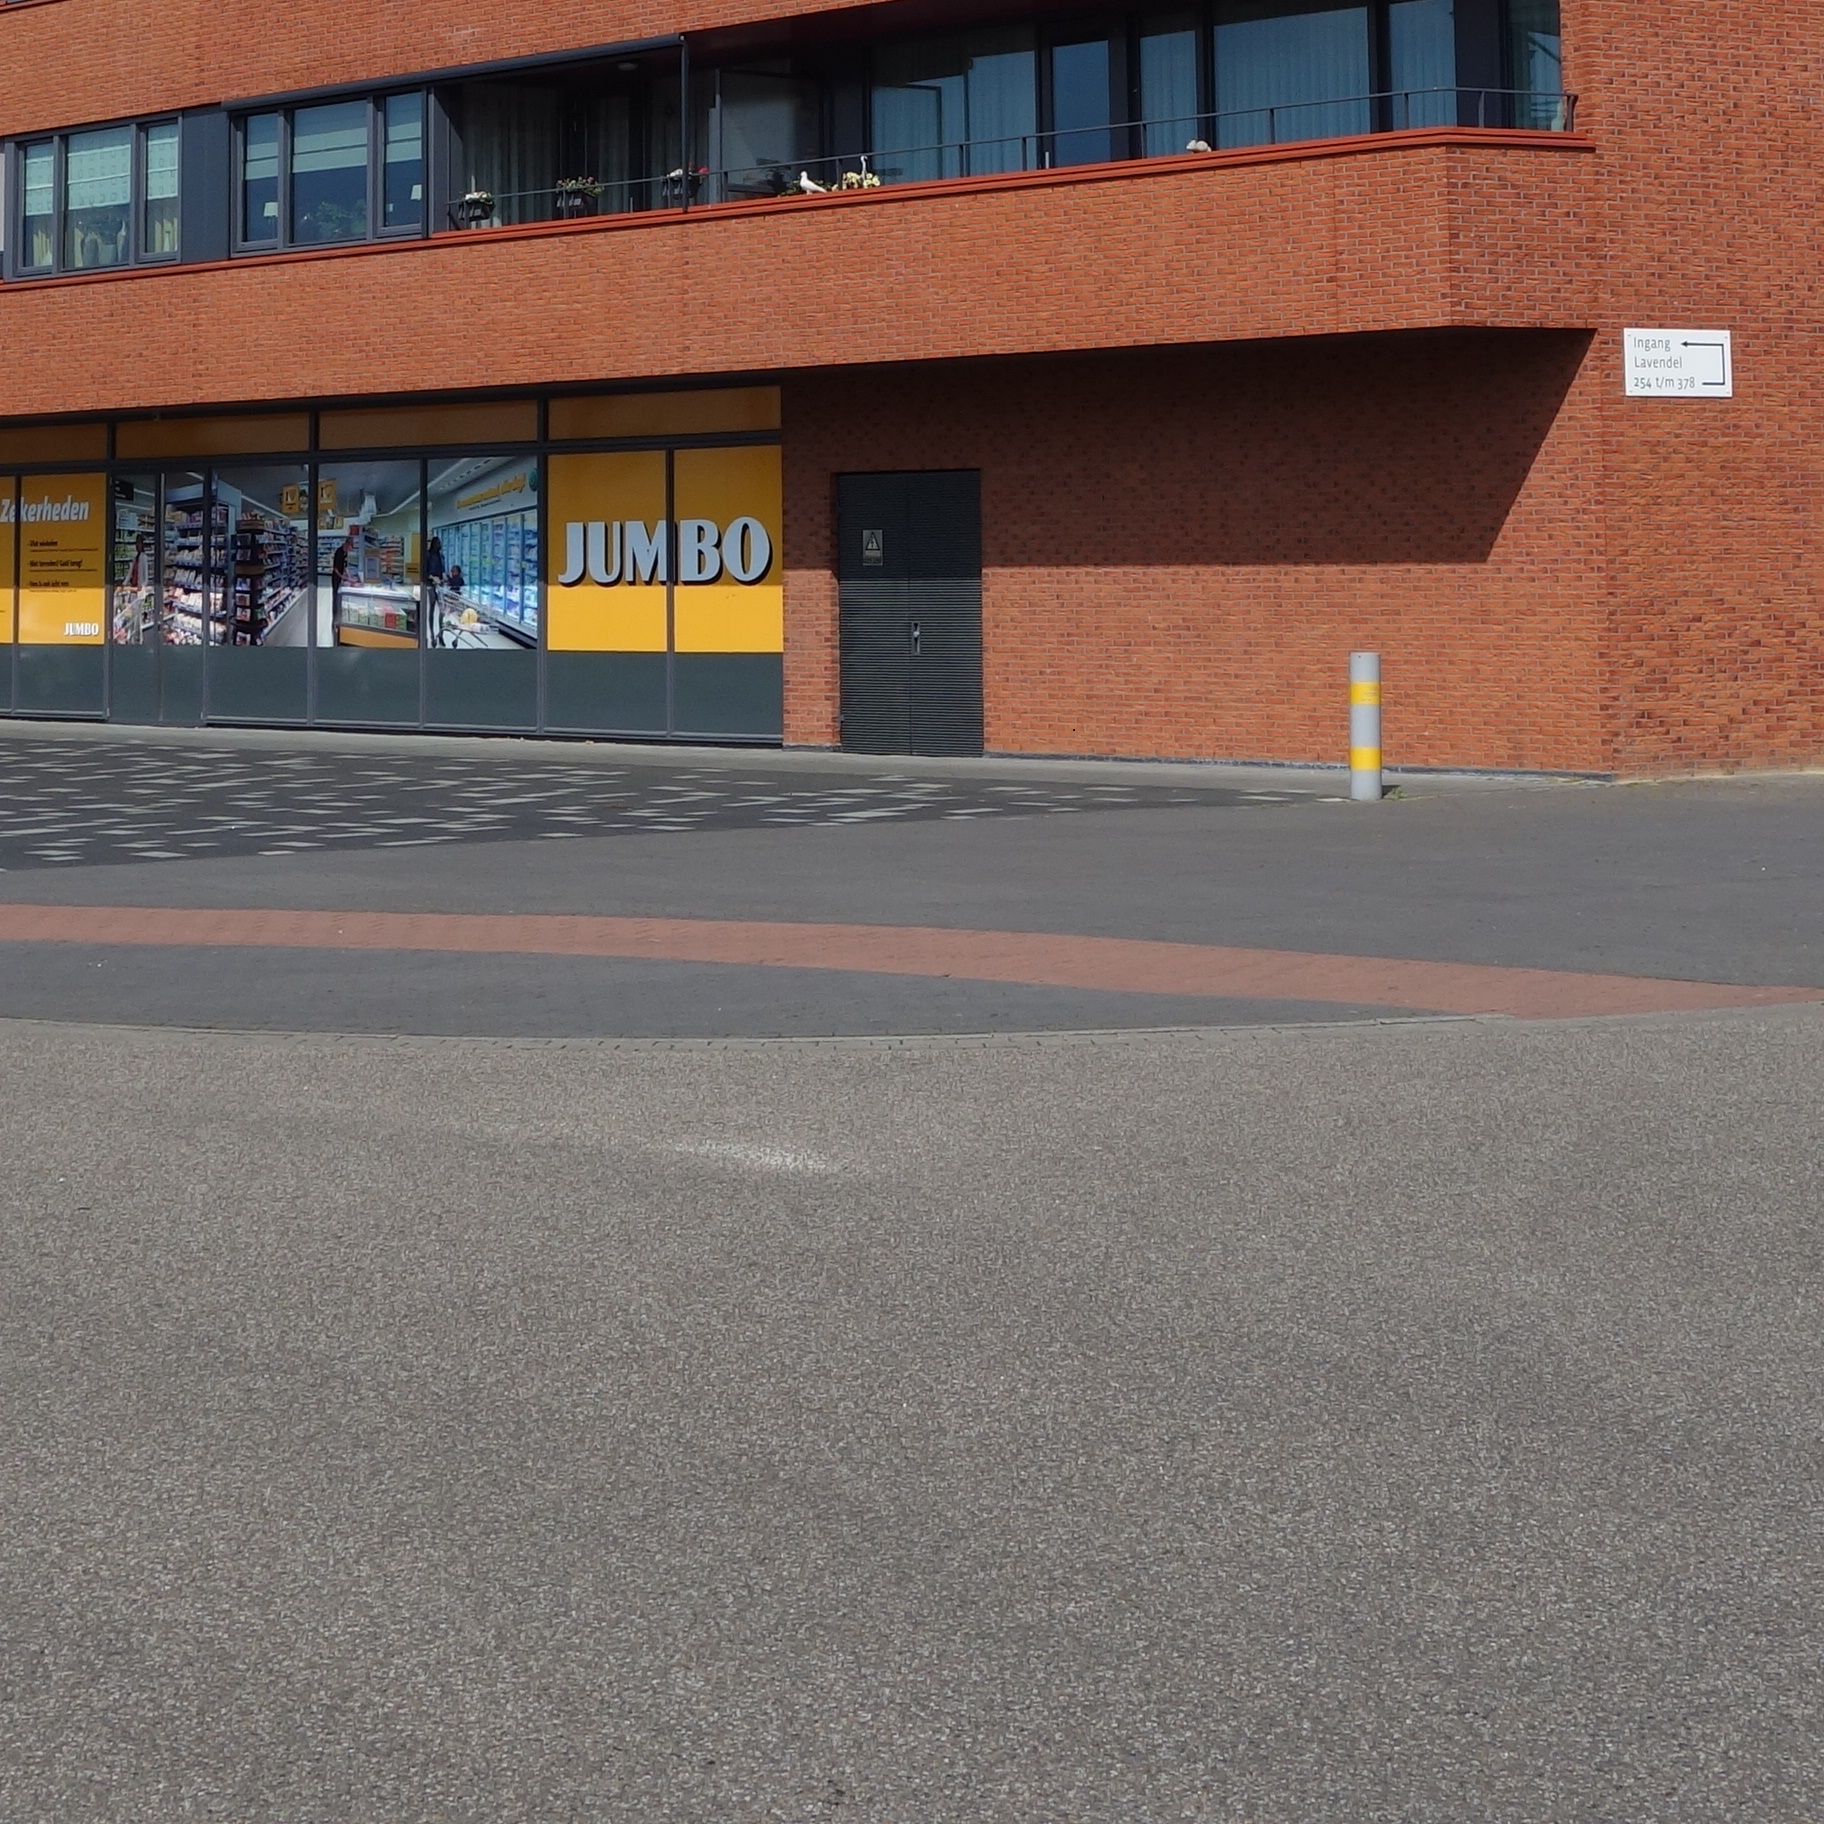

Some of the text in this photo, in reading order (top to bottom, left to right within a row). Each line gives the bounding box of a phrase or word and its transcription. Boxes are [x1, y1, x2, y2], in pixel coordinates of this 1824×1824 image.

[1633, 336, 1671, 352] Ingang
[1634, 356, 1683, 369] Lavendel
[1633, 376, 1696, 390] 254 t/m 378
[0, 495, 90, 524] Zekerheden
[557, 516, 773, 586] JUMBO
[64, 622, 100, 636] JUMBO
